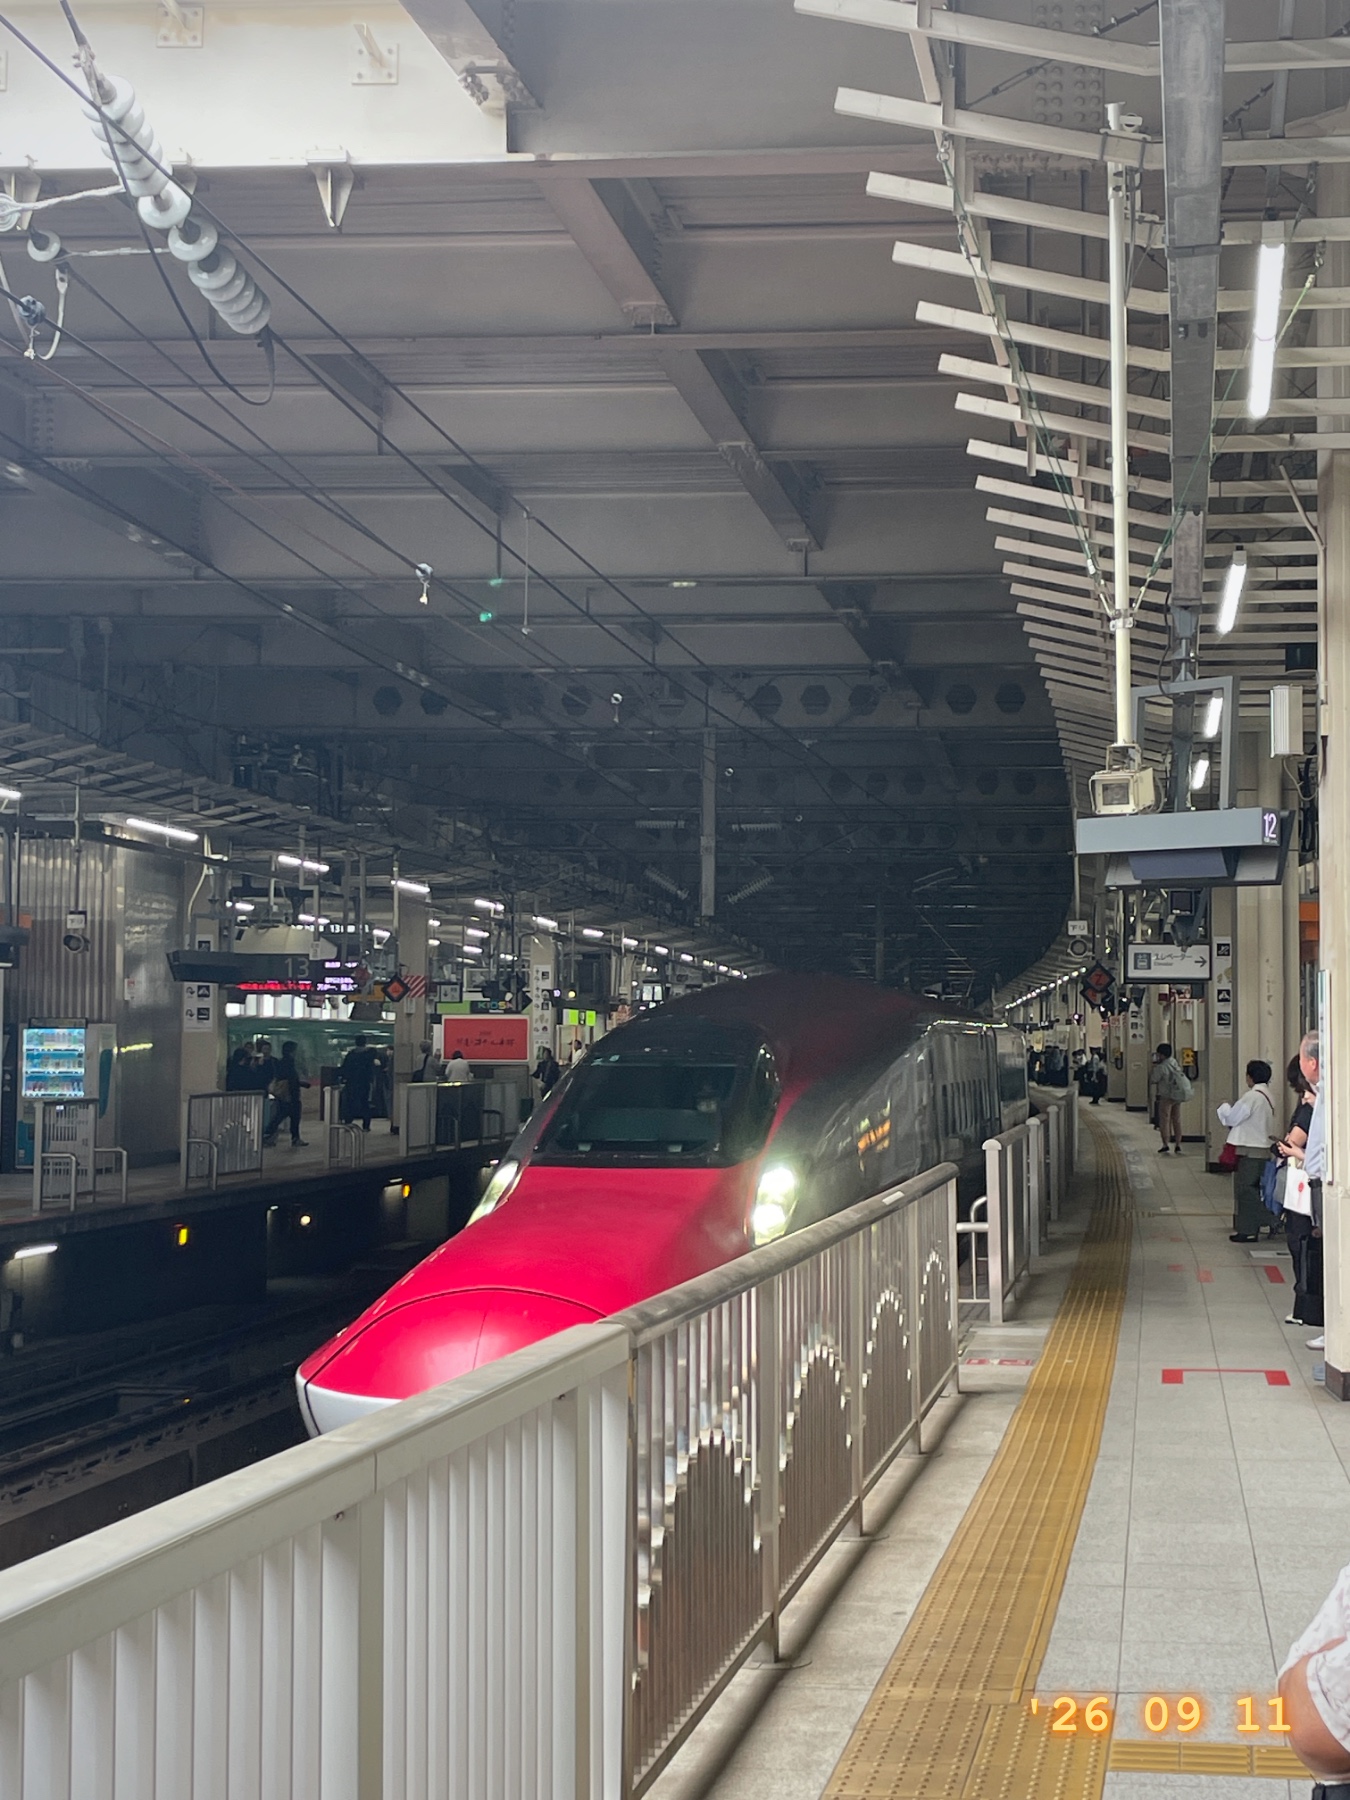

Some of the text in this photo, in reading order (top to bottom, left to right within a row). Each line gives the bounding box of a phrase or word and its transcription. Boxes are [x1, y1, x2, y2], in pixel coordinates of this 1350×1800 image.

[1263, 812, 1277, 838] 12
[1153, 952, 1194, 961] エレベーター
[285, 957, 309, 978] 13
[477, 1001, 513, 1010] KIOSK
